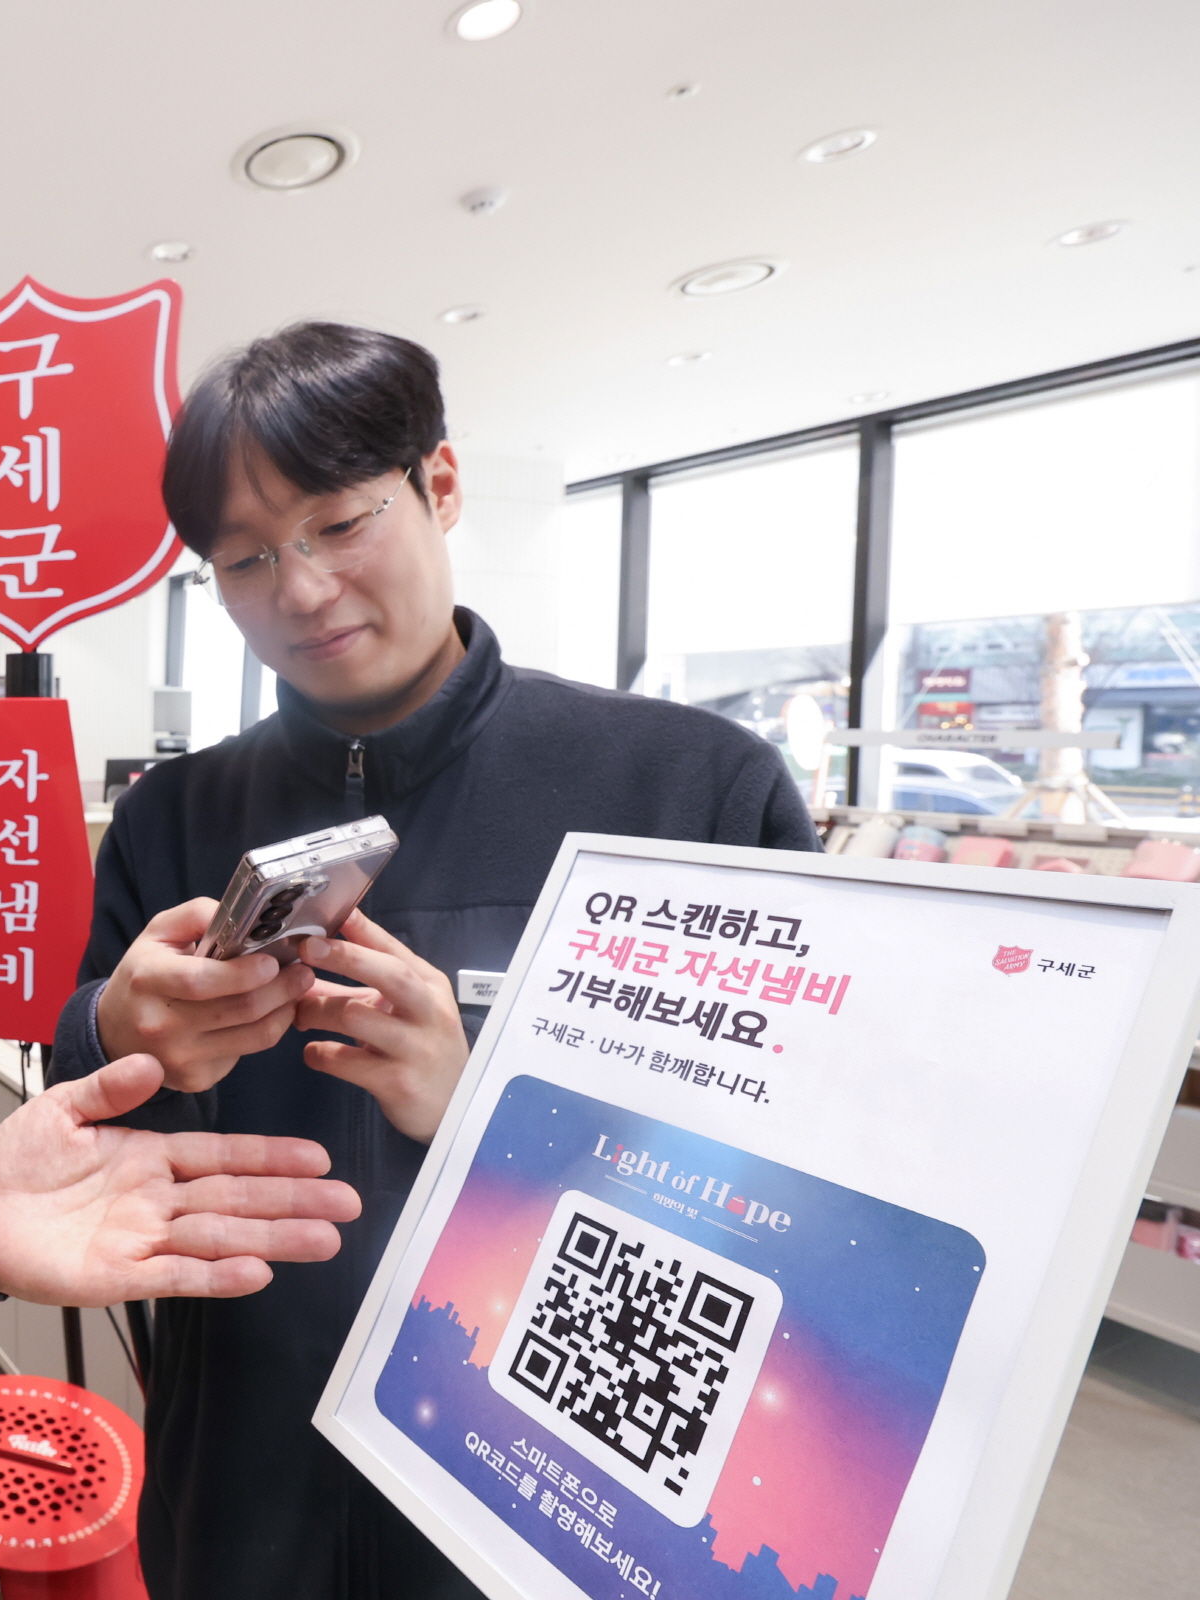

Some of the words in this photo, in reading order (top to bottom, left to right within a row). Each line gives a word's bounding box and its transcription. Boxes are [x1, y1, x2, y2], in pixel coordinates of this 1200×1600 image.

[585, 891, 638, 926] QR
[641, 899, 811, 958] 스캔하고,
[1003, 949, 1018, 957] THE
[568, 929, 670, 978] 구세군
[674, 949, 852, 1016] 자선냄비
[994, 953, 1030, 967] SALVATION
[1003, 961, 1026, 971] ARMY
[1037, 958, 1096, 980] 구세군
[532, 1017, 586, 1049] 구세군
[598, 1037, 646, 1066] U+가
[649, 1050, 770, 1105] 함께합니다.
[591, 1133, 671, 1185] Light
[671, 1173, 701, 1196] of
[652, 1192, 686, 1214] 희망의
[685, 1206, 699, 1220] 빛
[509, 1437, 619, 1529] 스마트폰으로
[464, 1431, 539, 1502] QR코드를
[537, 1488, 662, 1600] 촬영해보세요!
